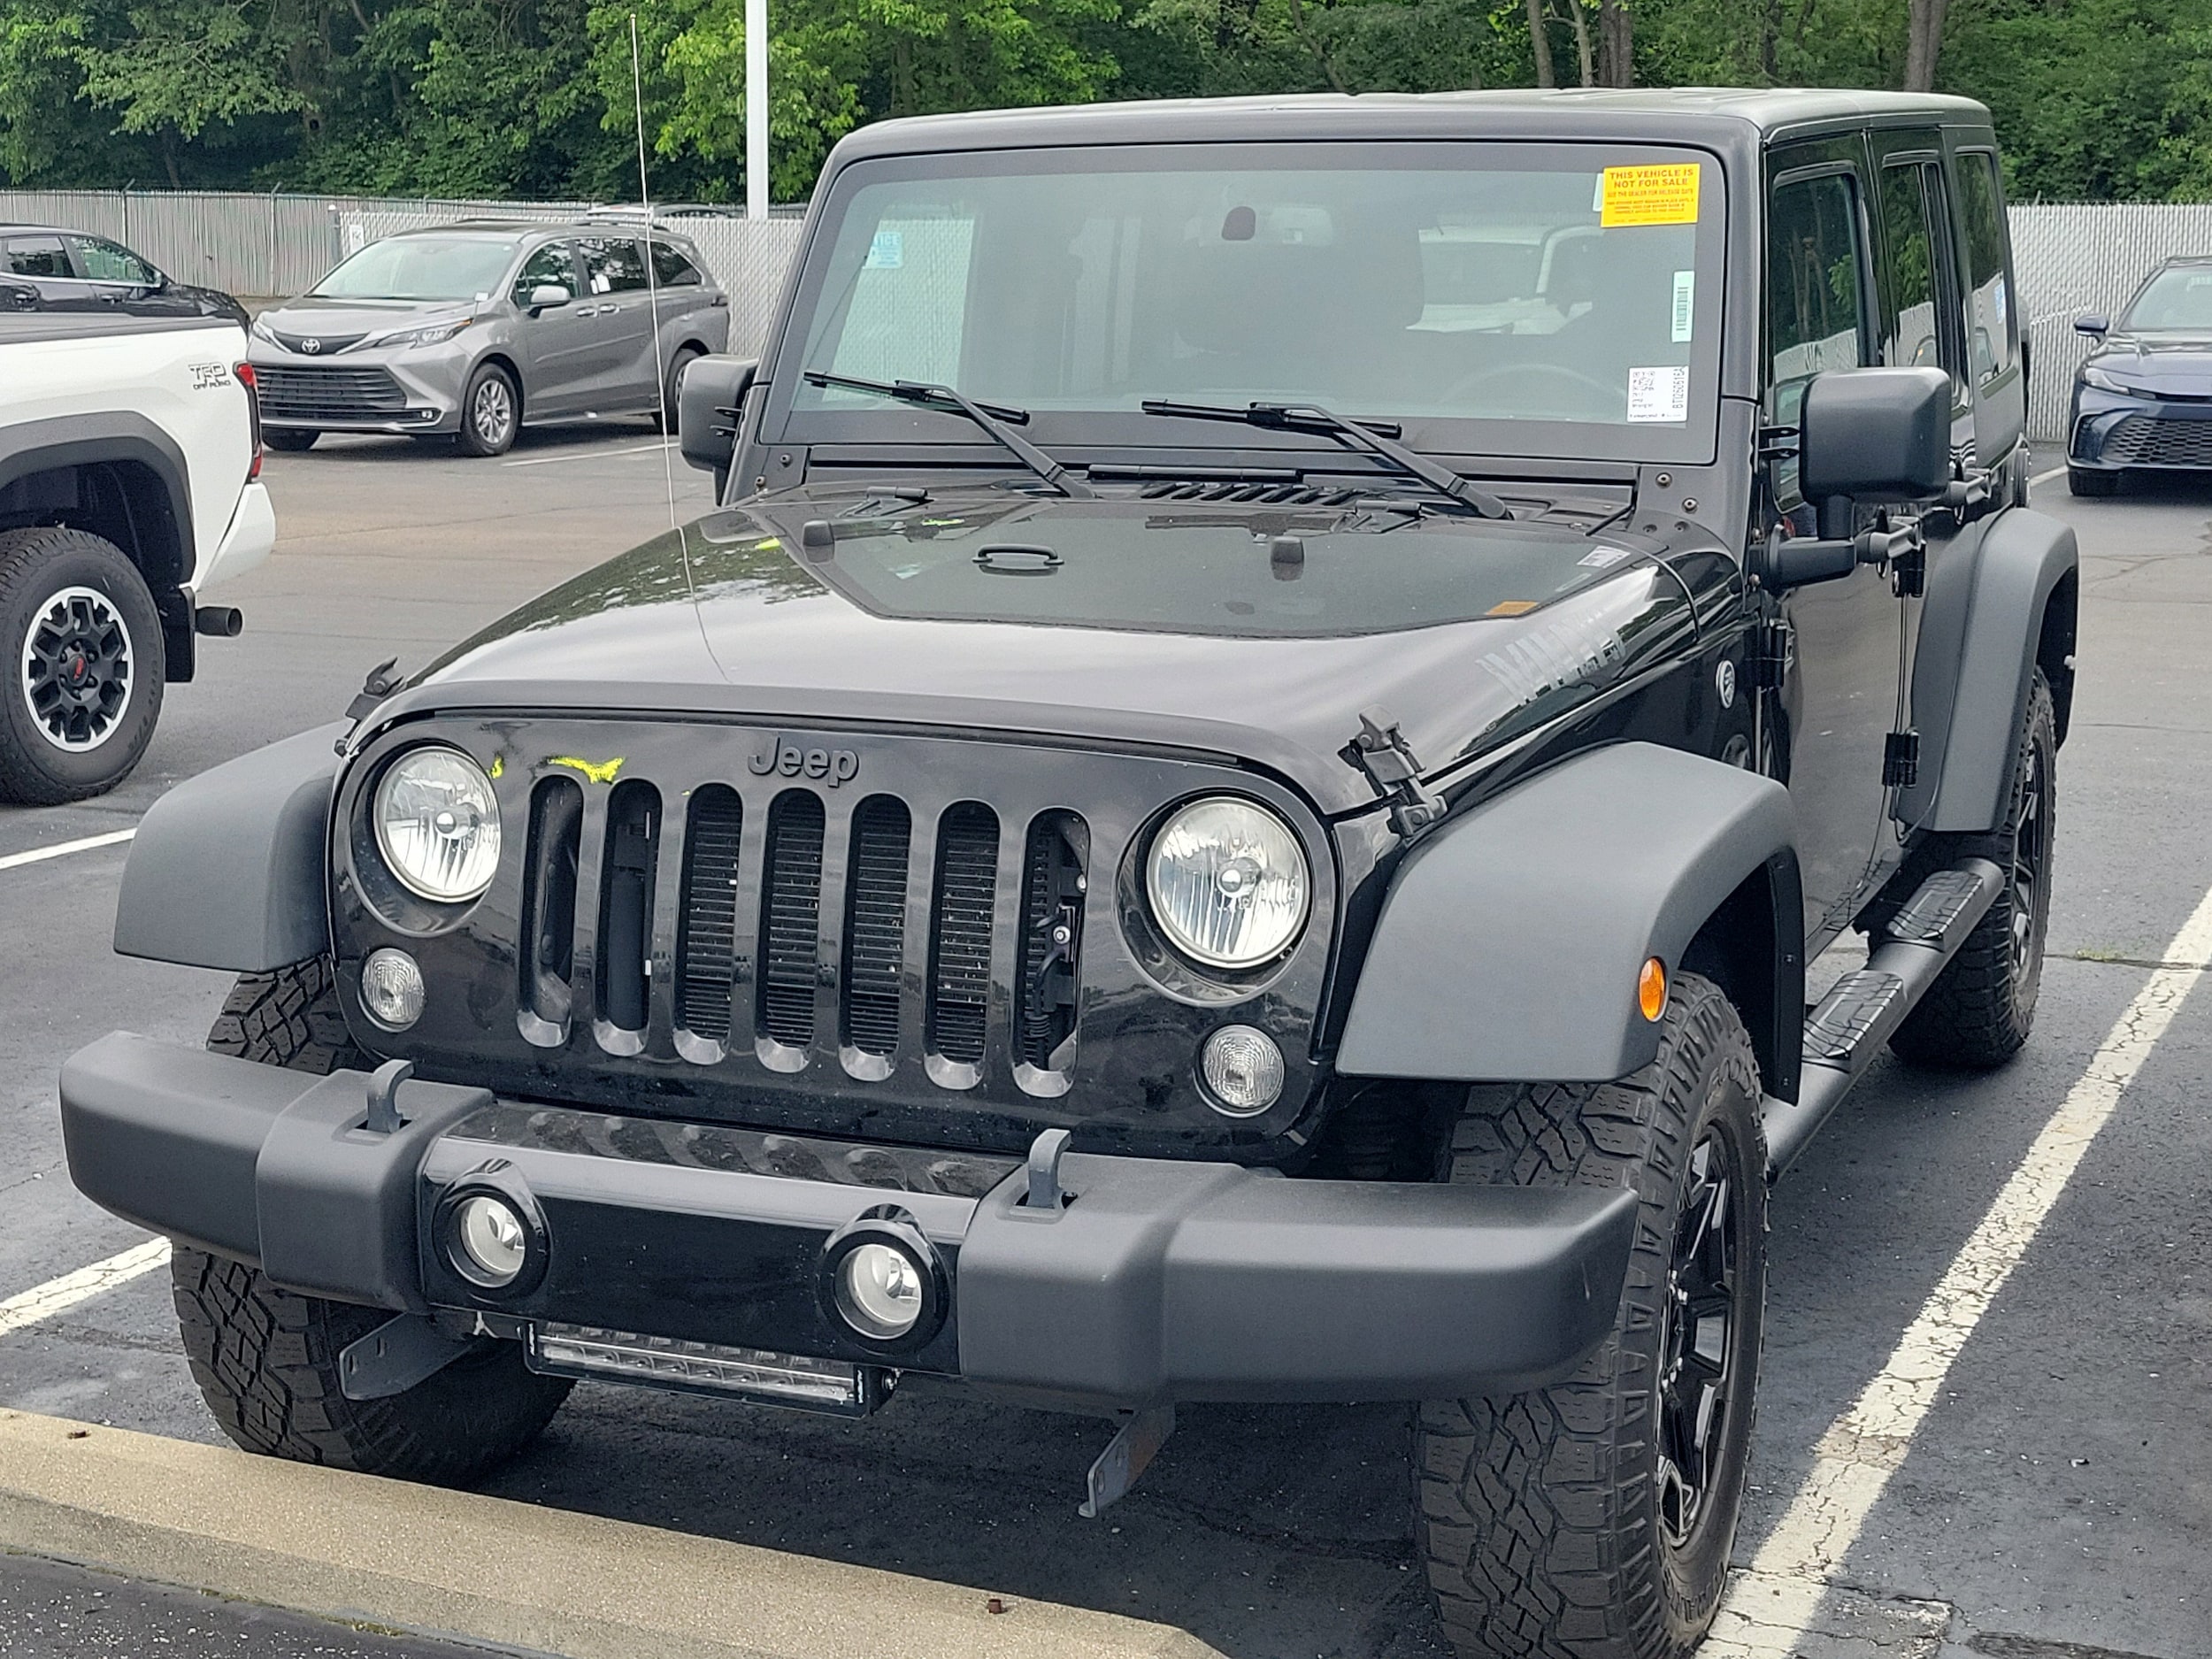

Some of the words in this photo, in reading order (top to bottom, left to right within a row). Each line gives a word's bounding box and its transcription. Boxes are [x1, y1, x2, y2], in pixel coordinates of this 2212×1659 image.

[1610, 171, 1632, 180] THIS
[1636, 169, 1680, 178] VEHICLE
[748, 736, 858, 788] Jeep
